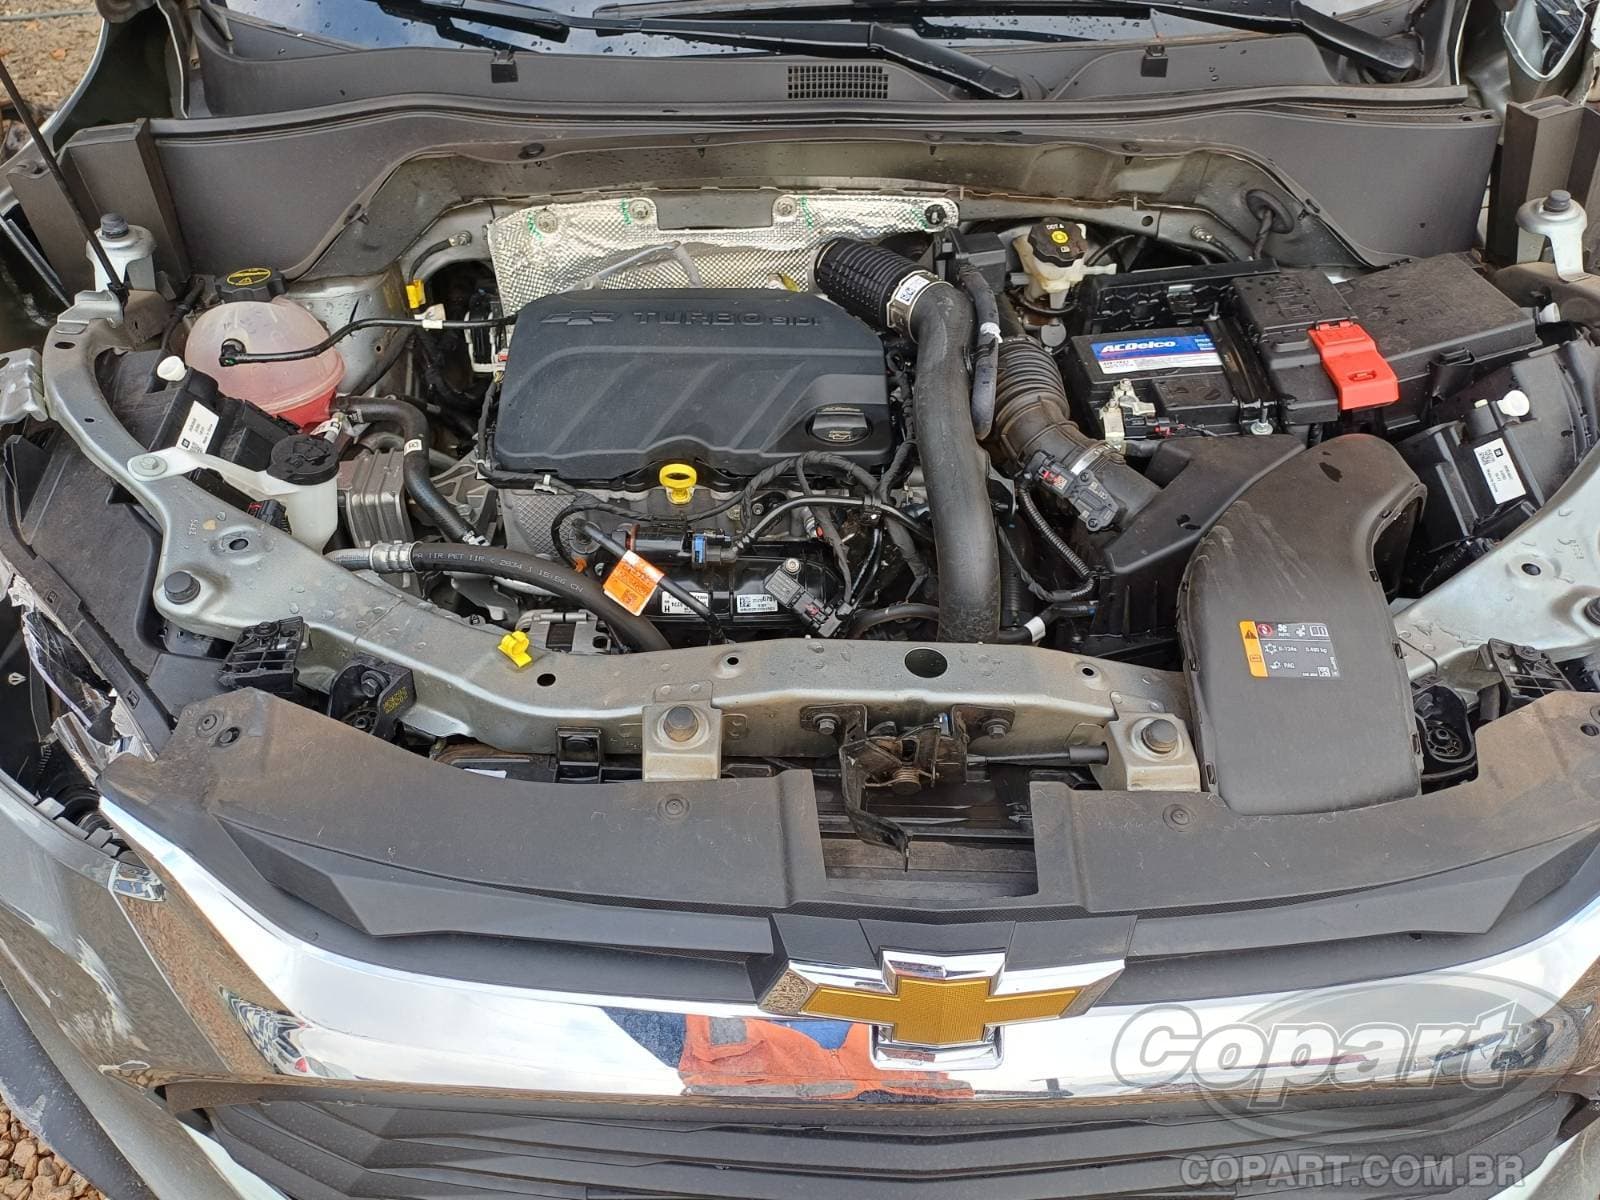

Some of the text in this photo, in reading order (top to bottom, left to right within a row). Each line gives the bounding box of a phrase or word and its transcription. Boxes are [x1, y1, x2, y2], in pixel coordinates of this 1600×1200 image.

[633, 311, 764, 326] TURBO
[1101, 340, 1177, 353] ACDelco
[664, 605, 671, 613] H
